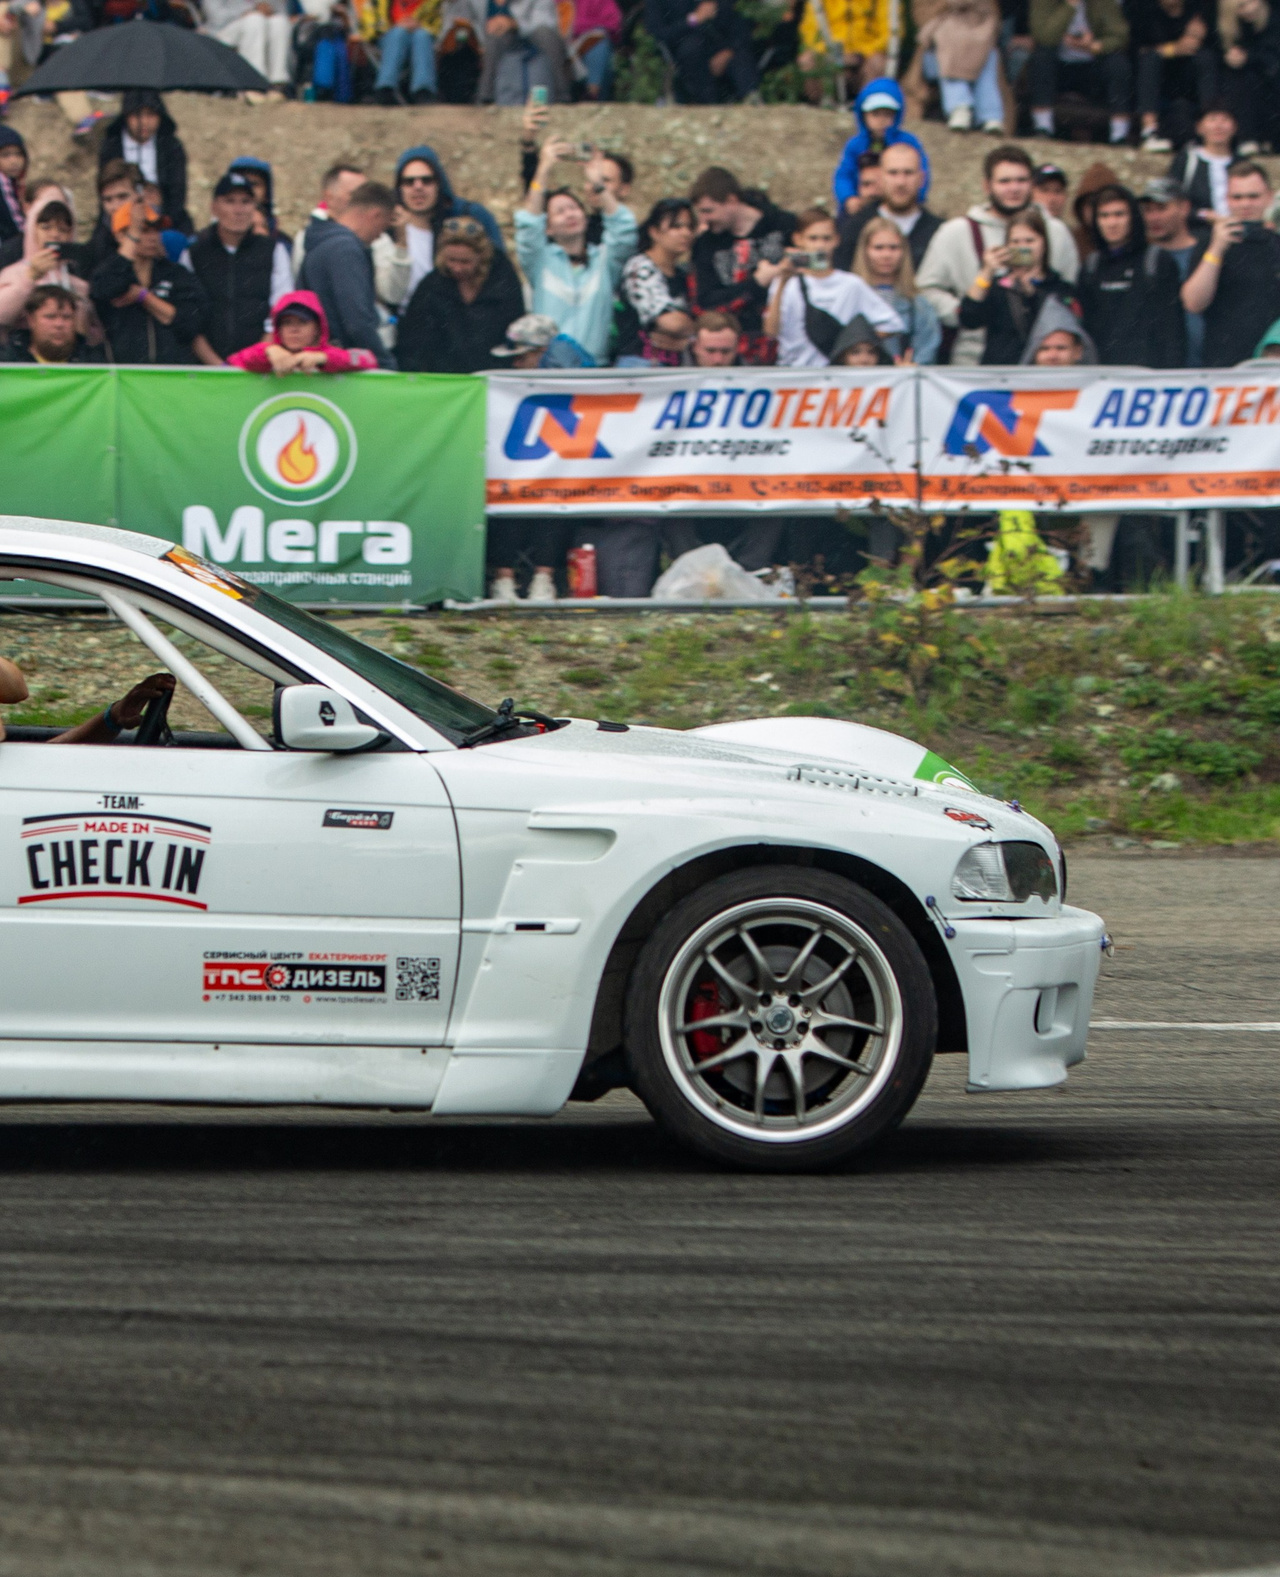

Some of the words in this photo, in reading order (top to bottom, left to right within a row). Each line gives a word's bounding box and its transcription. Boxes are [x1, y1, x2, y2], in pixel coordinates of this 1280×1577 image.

[653, 388, 892, 429] АВТОТЕМА
[648, 439, 791, 460] автосервис
[1086, 436, 1229, 460] автосервис
[182, 505, 412, 565] Мега
[83, 821, 128, 833] MADE
[132, 822, 150, 834] IN
[26, 838, 154, 890] CHECK
[161, 843, 206, 895] IN
[203, 950, 268, 960] СЕРВИСНЫЙ
[270, 952, 304, 961] ЦЕНТР
[308, 952, 388, 962] ЕКАТЕРИНБУРГ
[292, 969, 382, 989] ДИЗЕЛЬ
